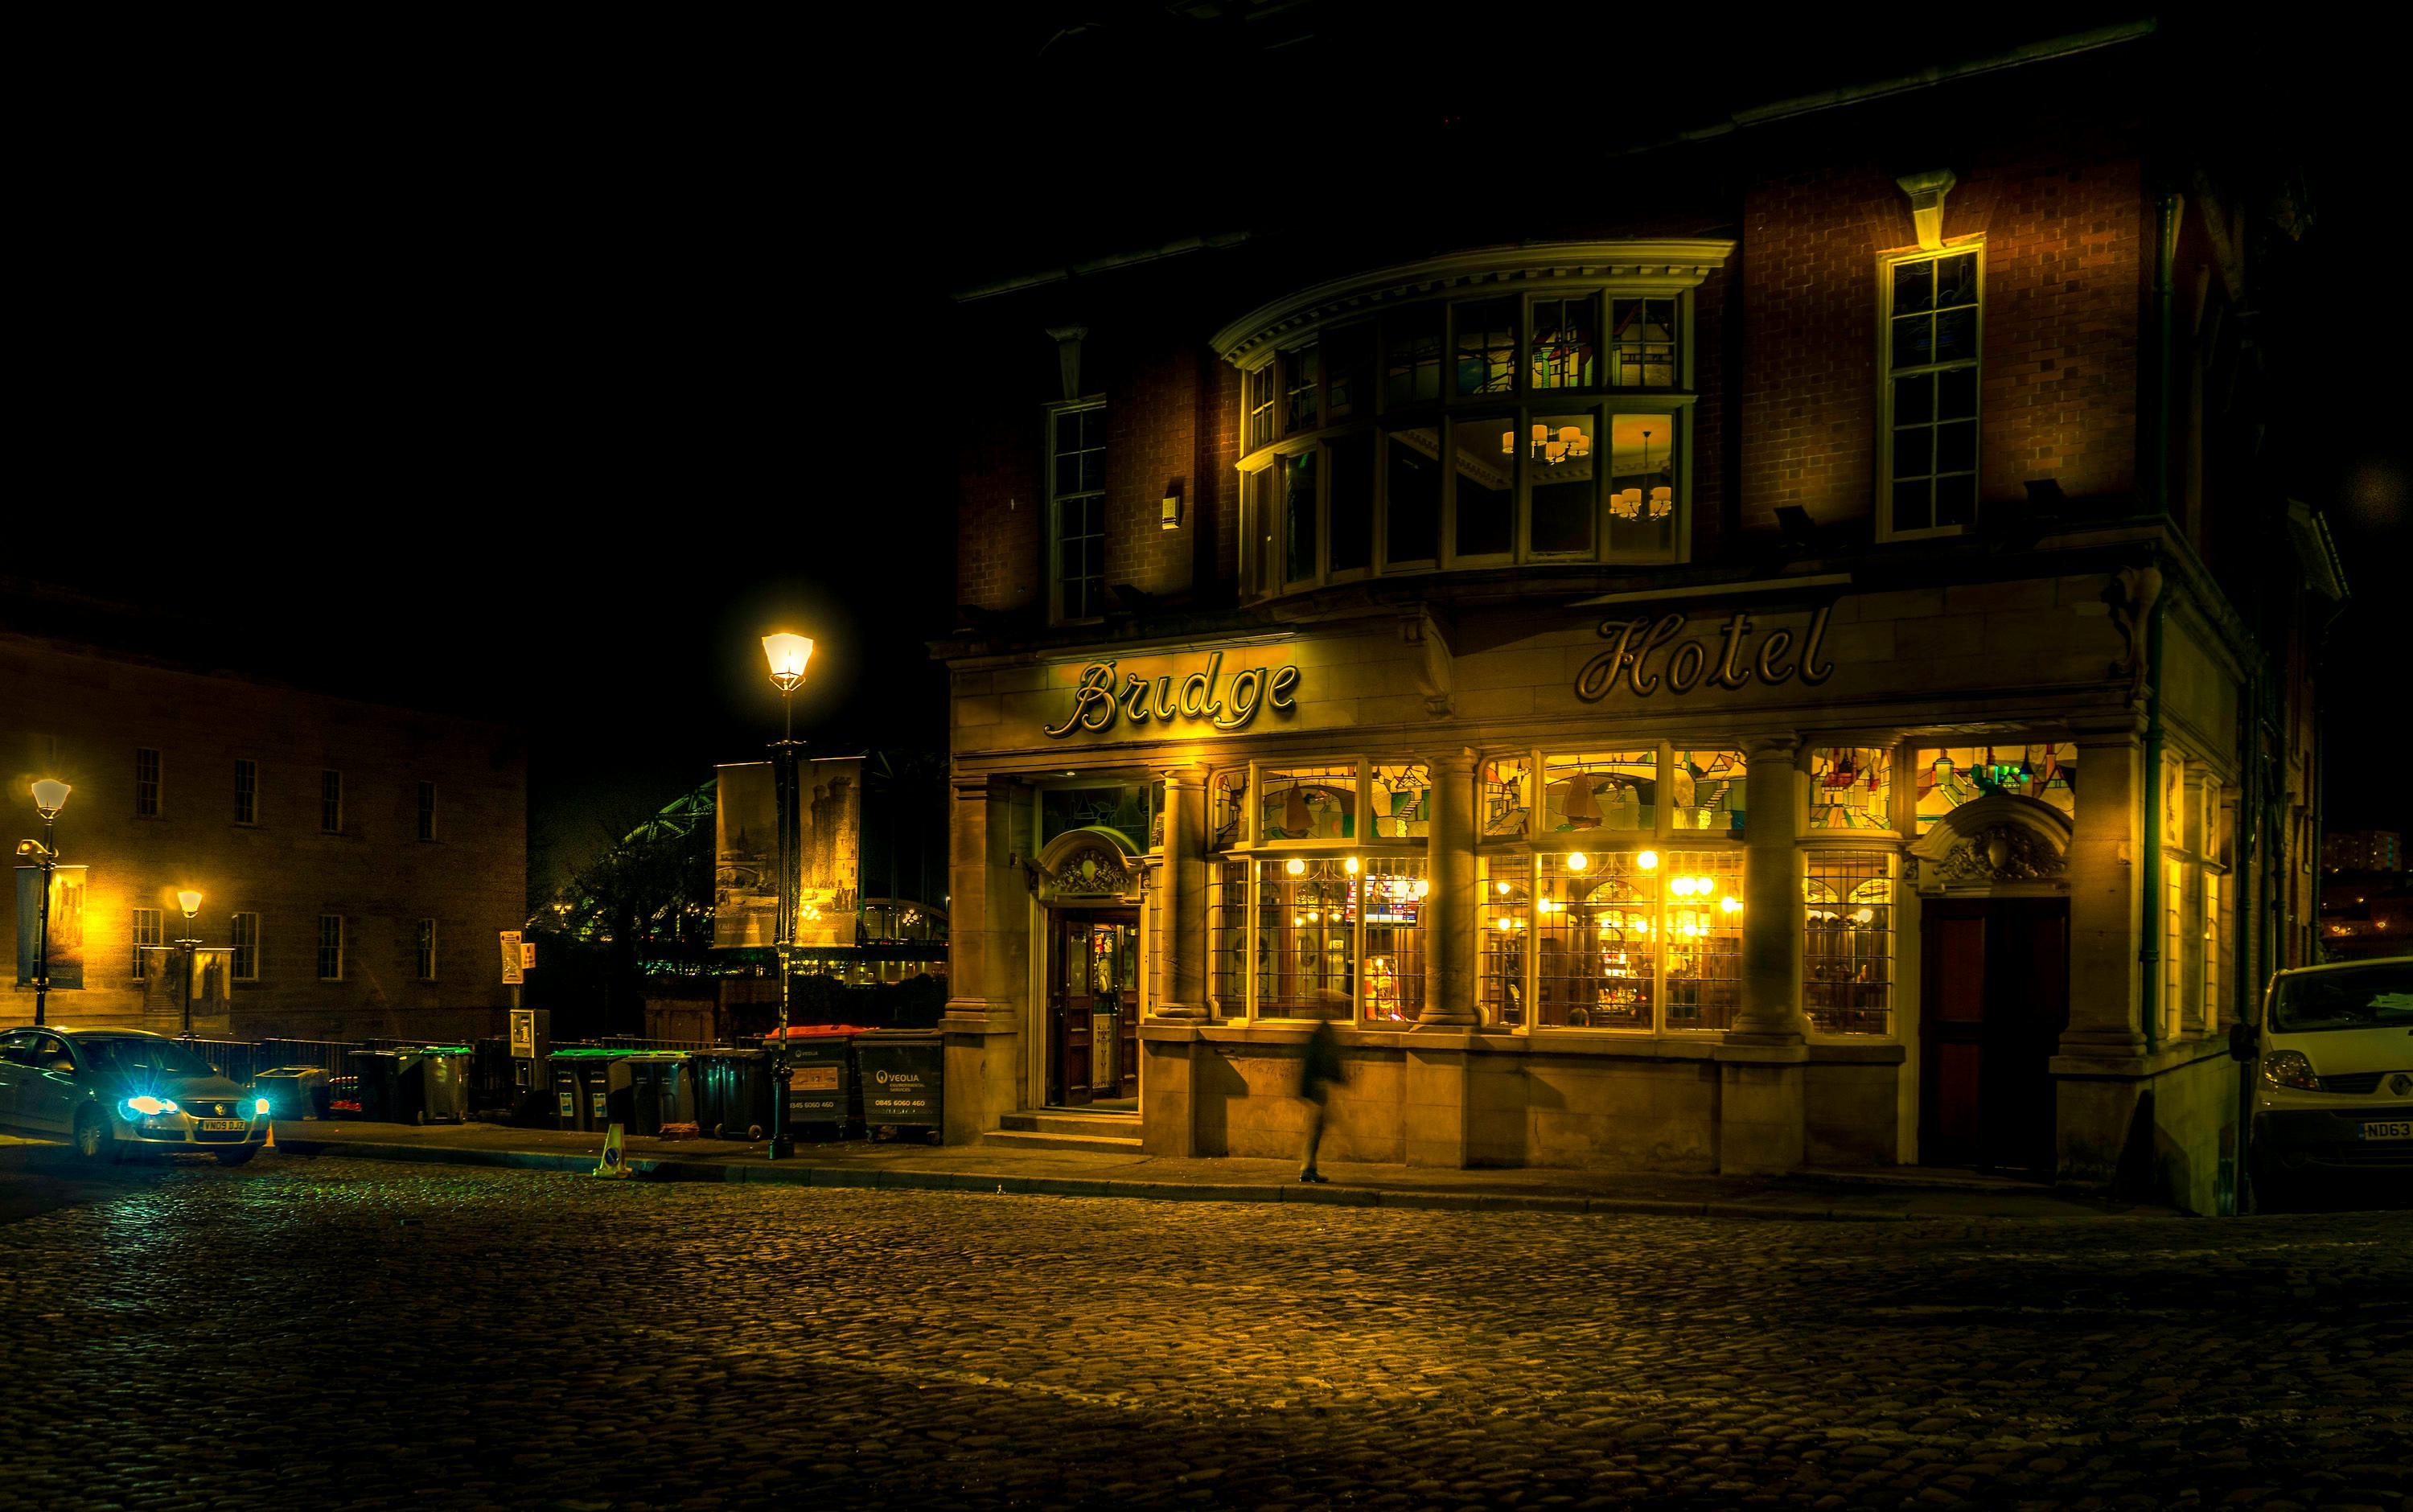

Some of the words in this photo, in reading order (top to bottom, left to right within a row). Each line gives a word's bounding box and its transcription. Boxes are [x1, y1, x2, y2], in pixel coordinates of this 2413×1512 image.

[1044, 651, 1300, 739] Bridge
[1574, 606, 1834, 703] Hotel
[2368, 1124, 2410, 1136] ND63
